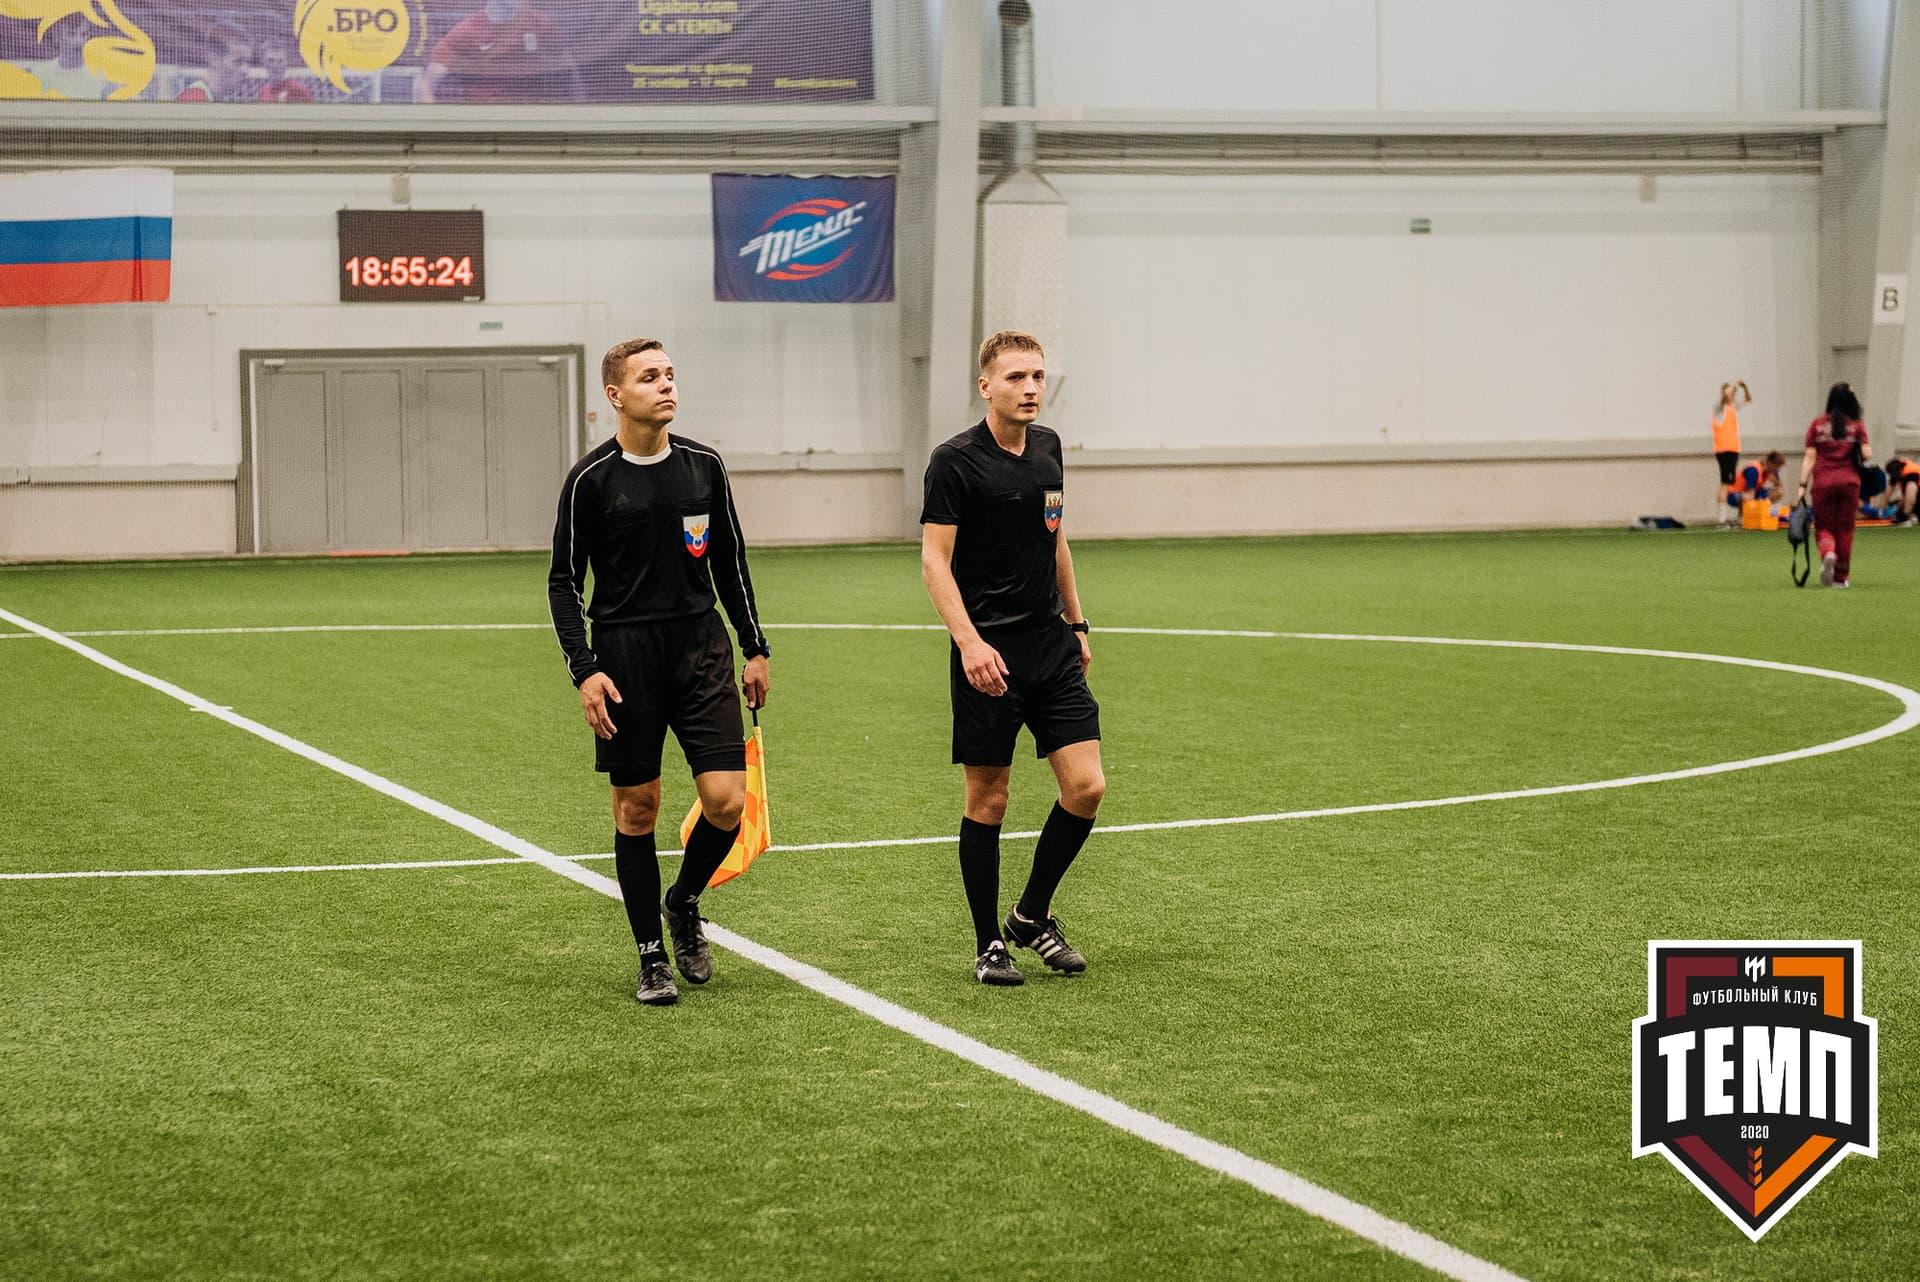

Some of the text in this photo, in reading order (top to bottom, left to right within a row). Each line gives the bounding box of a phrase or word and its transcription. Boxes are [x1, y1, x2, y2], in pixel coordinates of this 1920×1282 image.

[327, 8, 398, 33] .БРО
[638, 19, 662, 35] СК
[345, 255, 474, 287] 18:55:24
